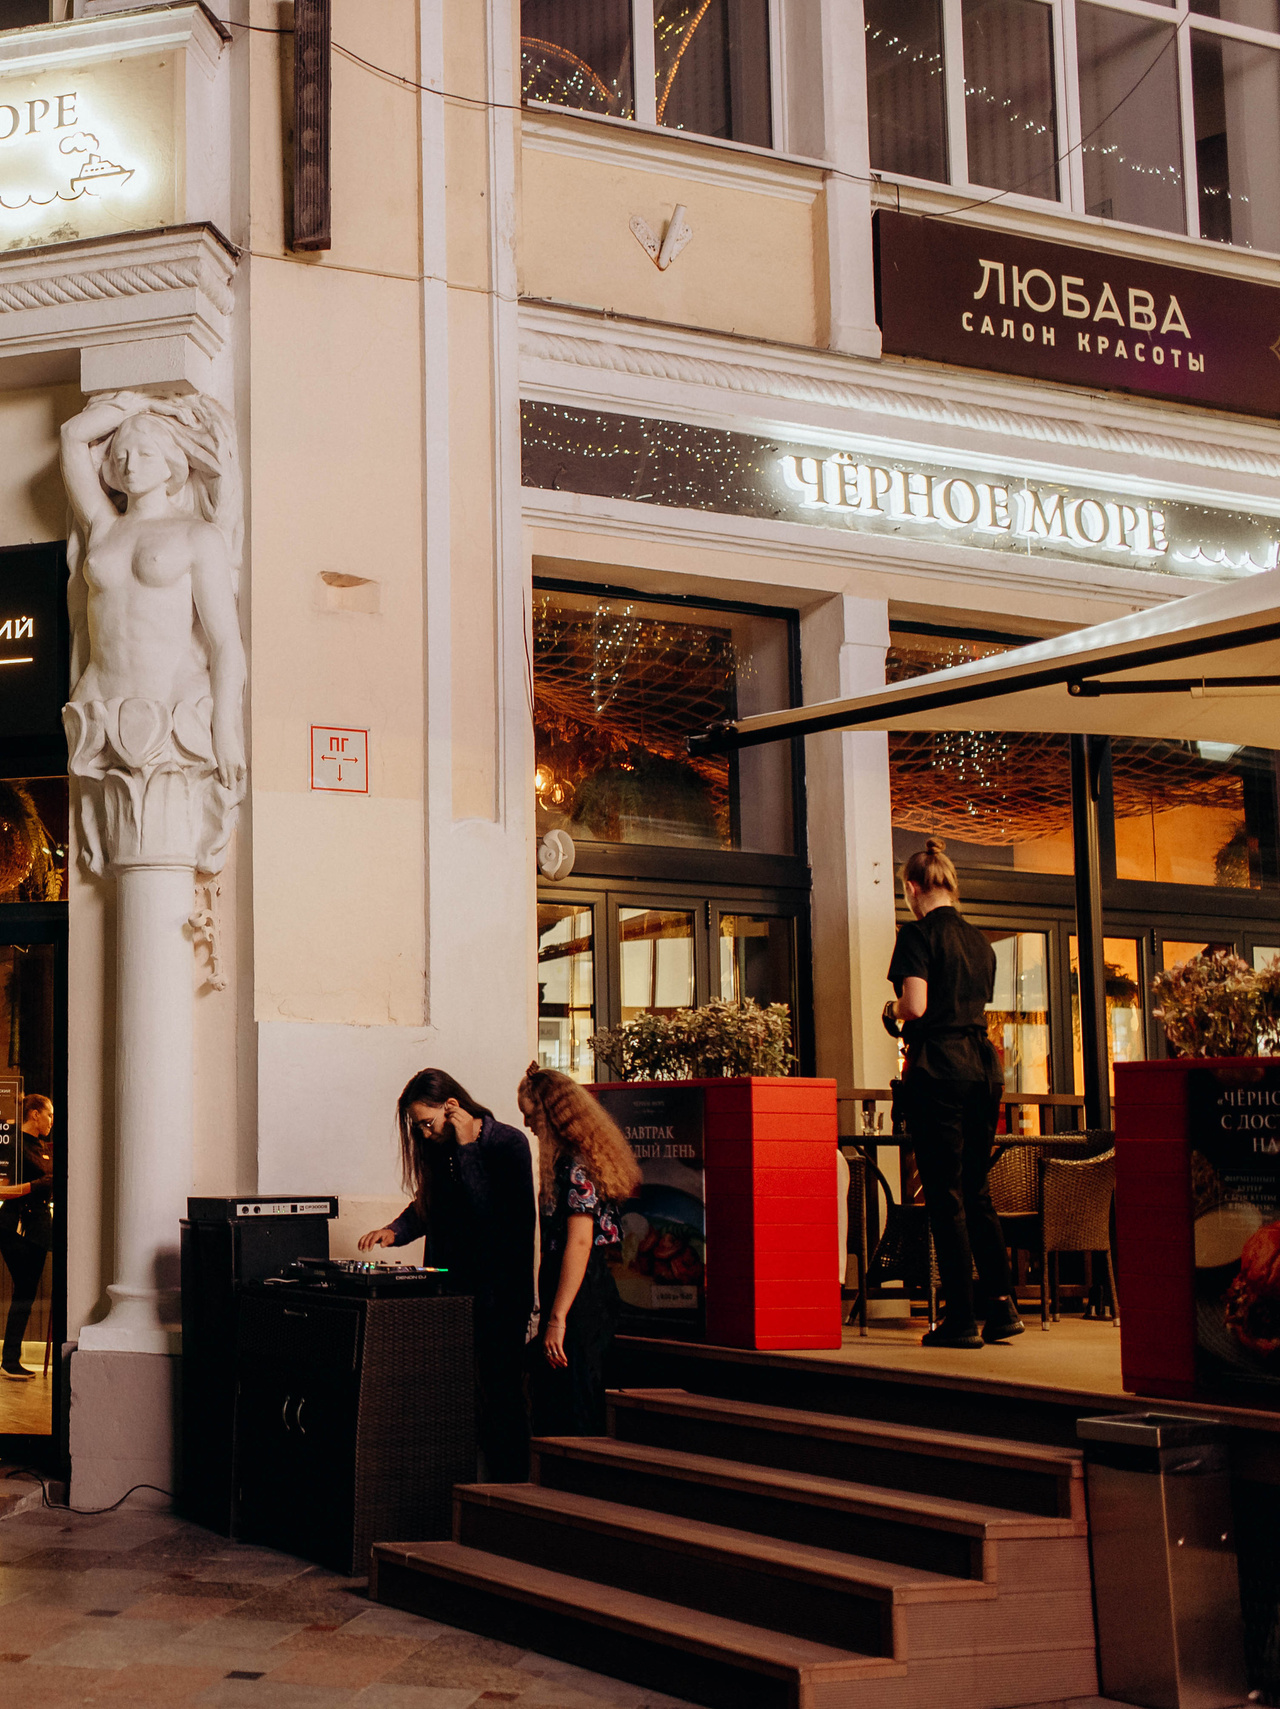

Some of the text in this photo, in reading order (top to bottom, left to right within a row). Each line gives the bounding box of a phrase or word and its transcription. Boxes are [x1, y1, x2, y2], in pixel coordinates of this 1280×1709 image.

[974, 258, 1191, 339] ЛЮБАВА
[962, 311, 1206, 373] САЛОН КРАСОТЫ
[784, 452, 1171, 556] ЧЁРНОЕ МОРЕ
[329, 736, 349, 752] ПГ
[1221, 1114, 1232, 1130] С
[624, 1126, 674, 1139] ЗАВТРАК
[663, 1144, 696, 1158] ДЕНЬ
